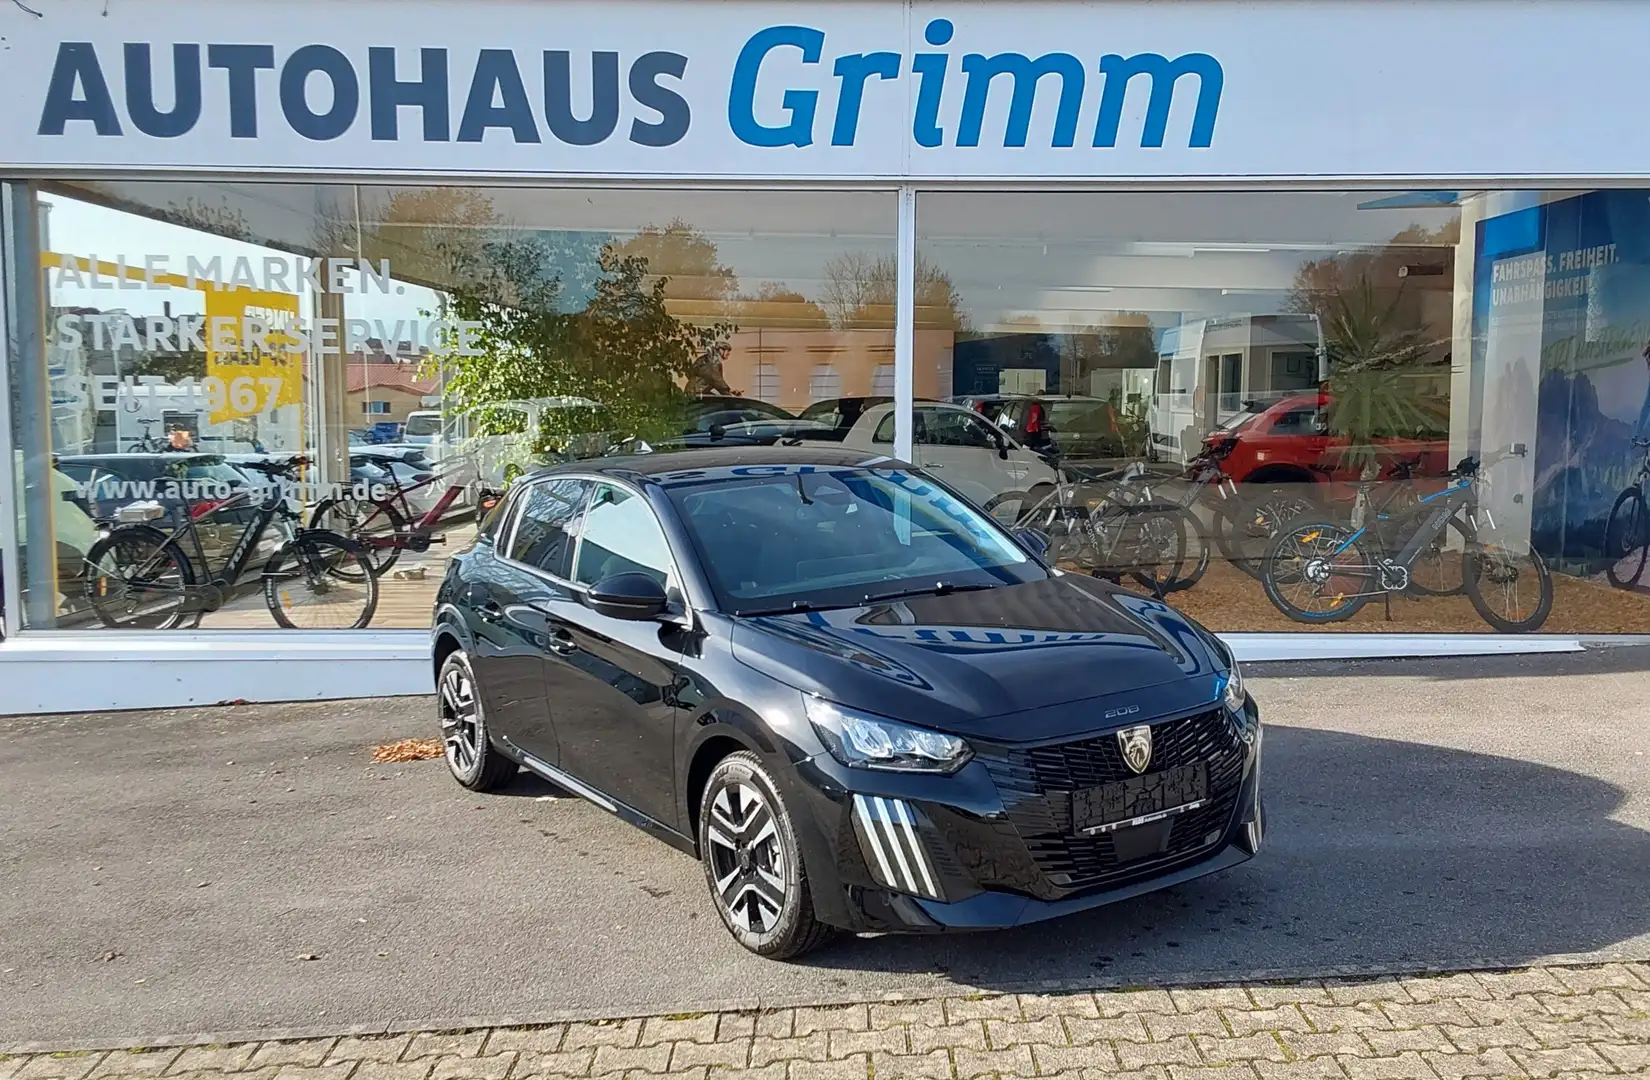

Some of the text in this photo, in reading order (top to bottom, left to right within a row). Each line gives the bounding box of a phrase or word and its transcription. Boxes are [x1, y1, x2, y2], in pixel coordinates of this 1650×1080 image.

[37, 18, 1224, 149] AUTOHAUS Grimm
[56, 253, 406, 295] ALLE MARKEN.
[1559, 243, 1620, 273] FREIHEIT.
[56, 314, 272, 353] STARKER
[284, 318, 485, 357] SERVICE
[62, 374, 284, 415] SEIT 1967
[76, 477, 387, 504] www.auto-grimm.de
[1105, 704, 1140, 719] 208
